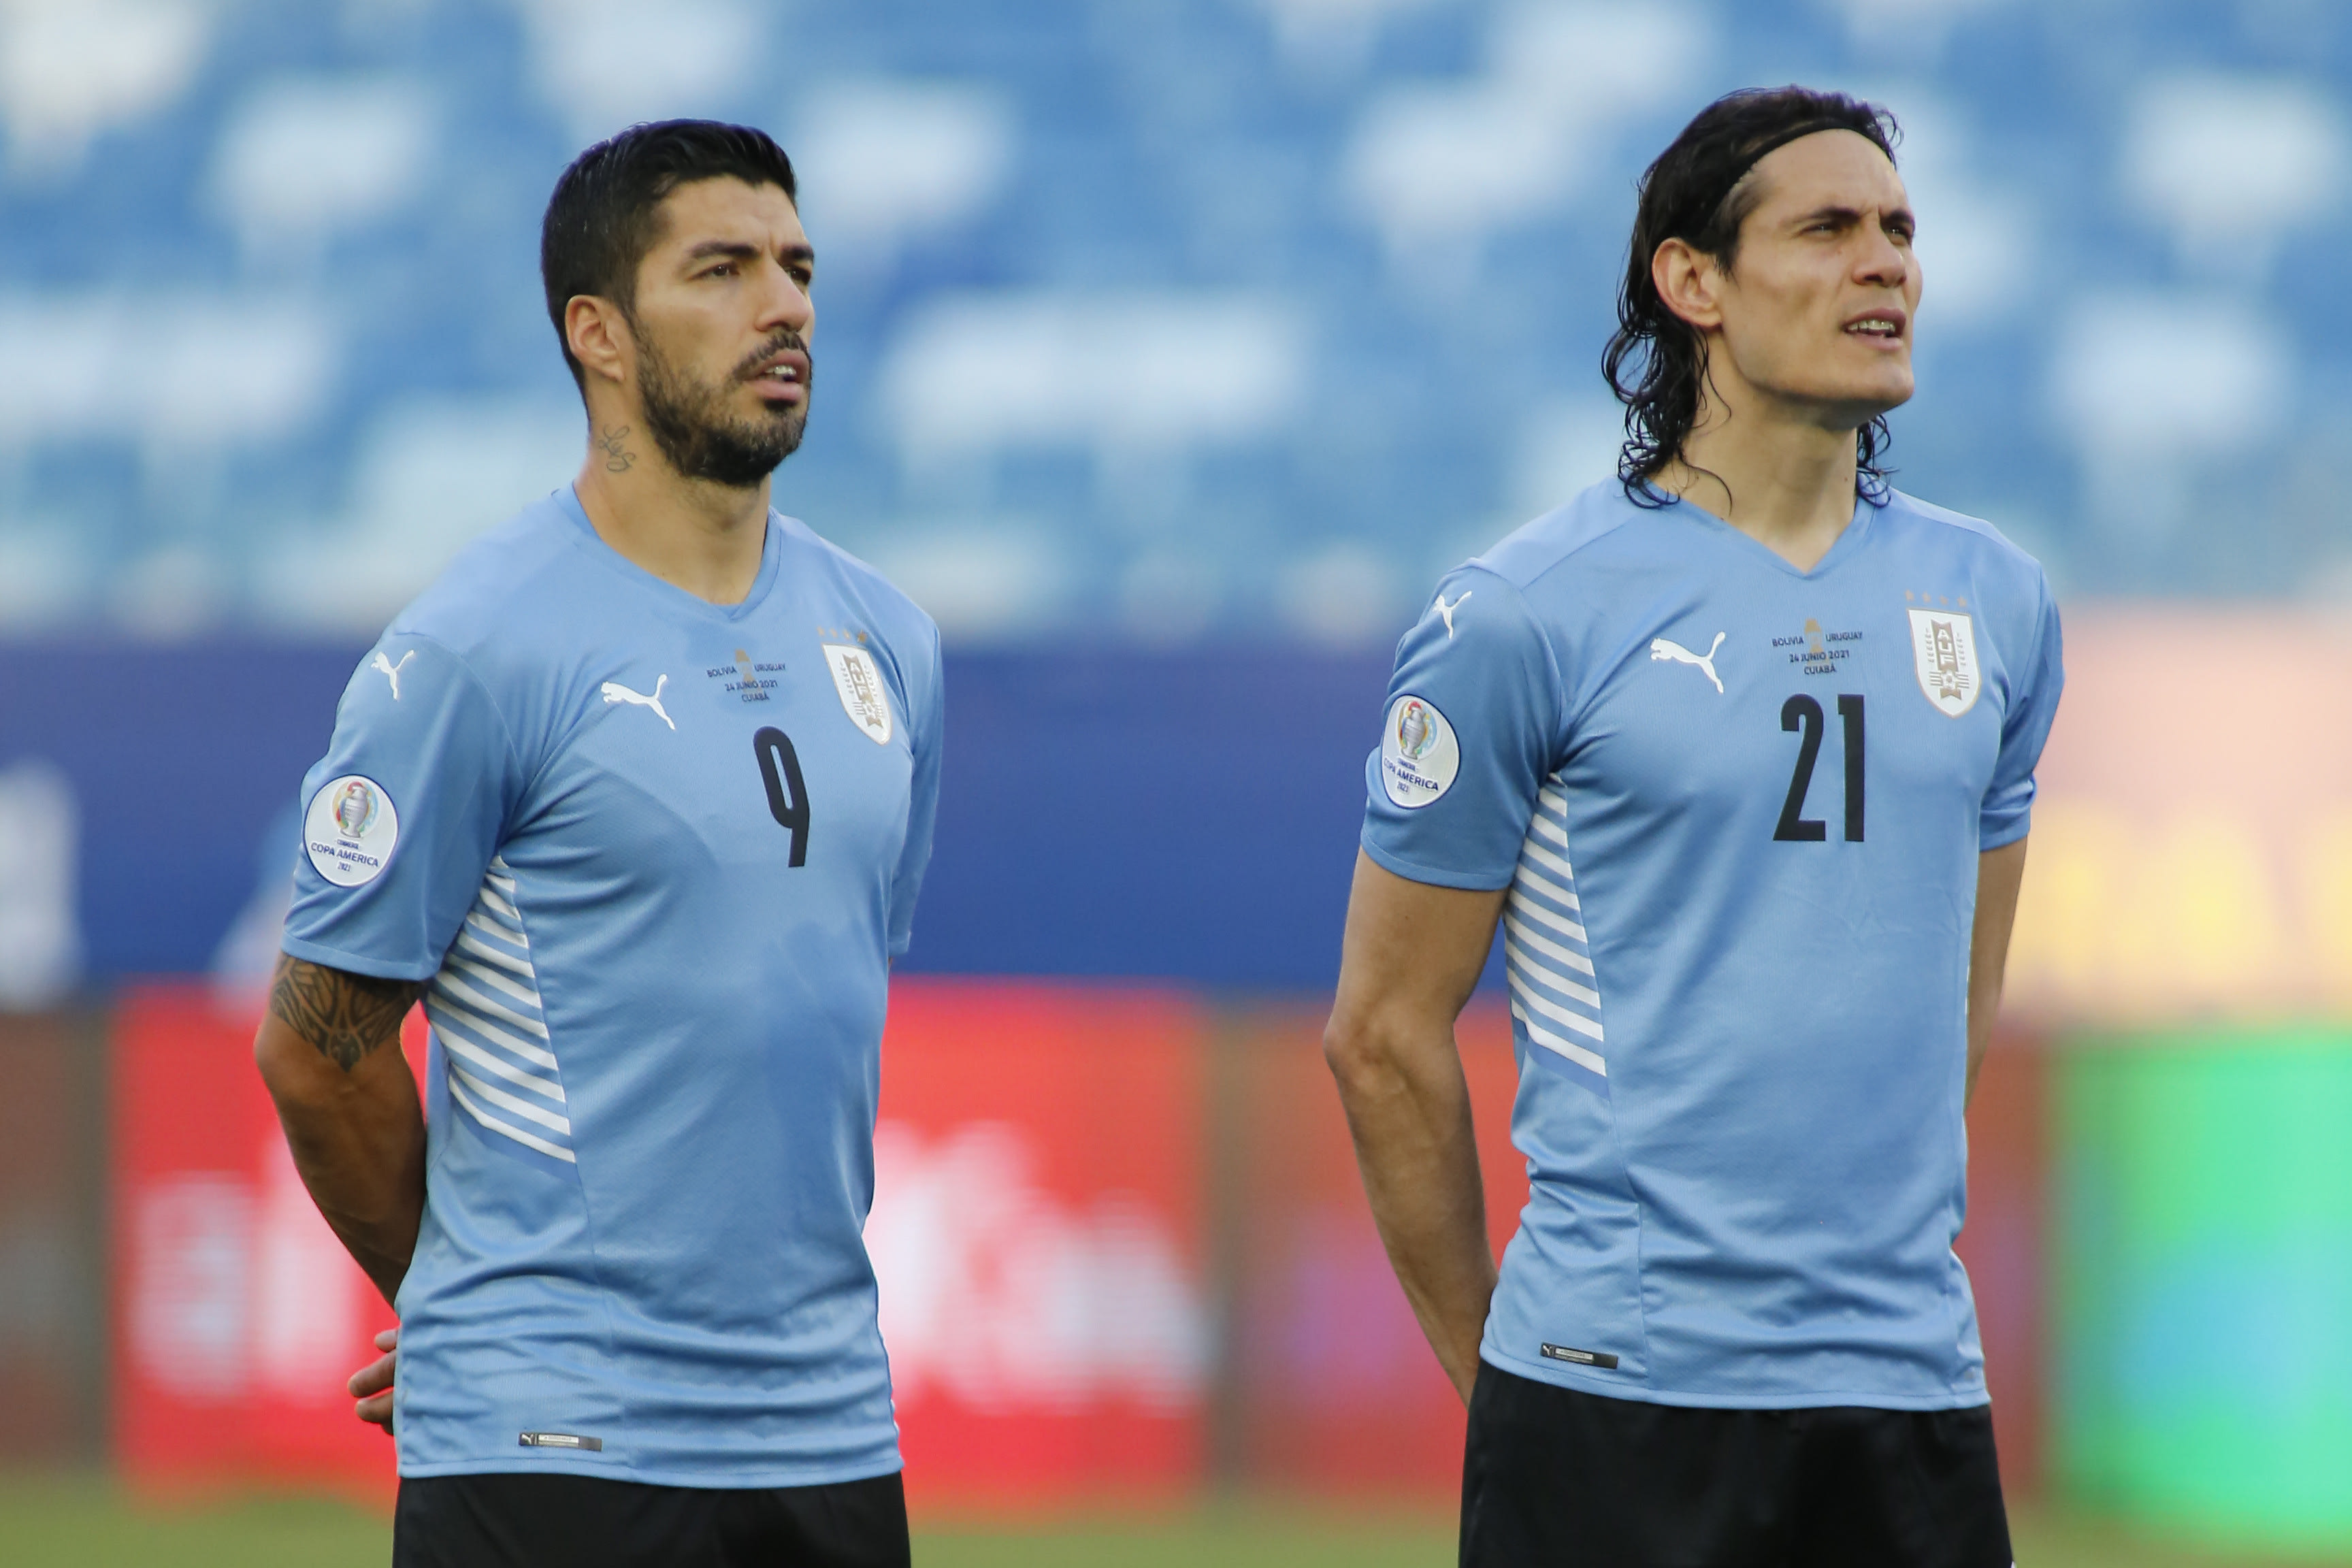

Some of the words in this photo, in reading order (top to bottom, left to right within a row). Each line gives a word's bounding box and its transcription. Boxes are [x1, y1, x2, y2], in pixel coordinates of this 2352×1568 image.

[1772, 636, 1804, 647] BOLIVIA
[1825, 631, 1863, 642] URUGUAY
[1789, 652, 1799, 663] 24
[1800, 651, 1827, 662] JUNIO
[1827, 649, 1850, 659] 2021
[707, 666, 738, 678] BOLIVIA
[753, 663, 786, 672] URUGUAY
[1803, 662, 1837, 675] CUIABÁ
[724, 682, 736, 691] 24
[736, 680, 759, 690] JUNIO
[758, 679, 779, 688] 2021
[741, 690, 770, 702] CUIABÁ
[1384, 757, 1396, 774] COPA
[1397, 768, 1439, 791] AMERICA
[1772, 693, 1865, 842] 21
[753, 725, 811, 868] 9
[311, 843, 335, 856] COPA
[336, 849, 378, 867] AMERICA
